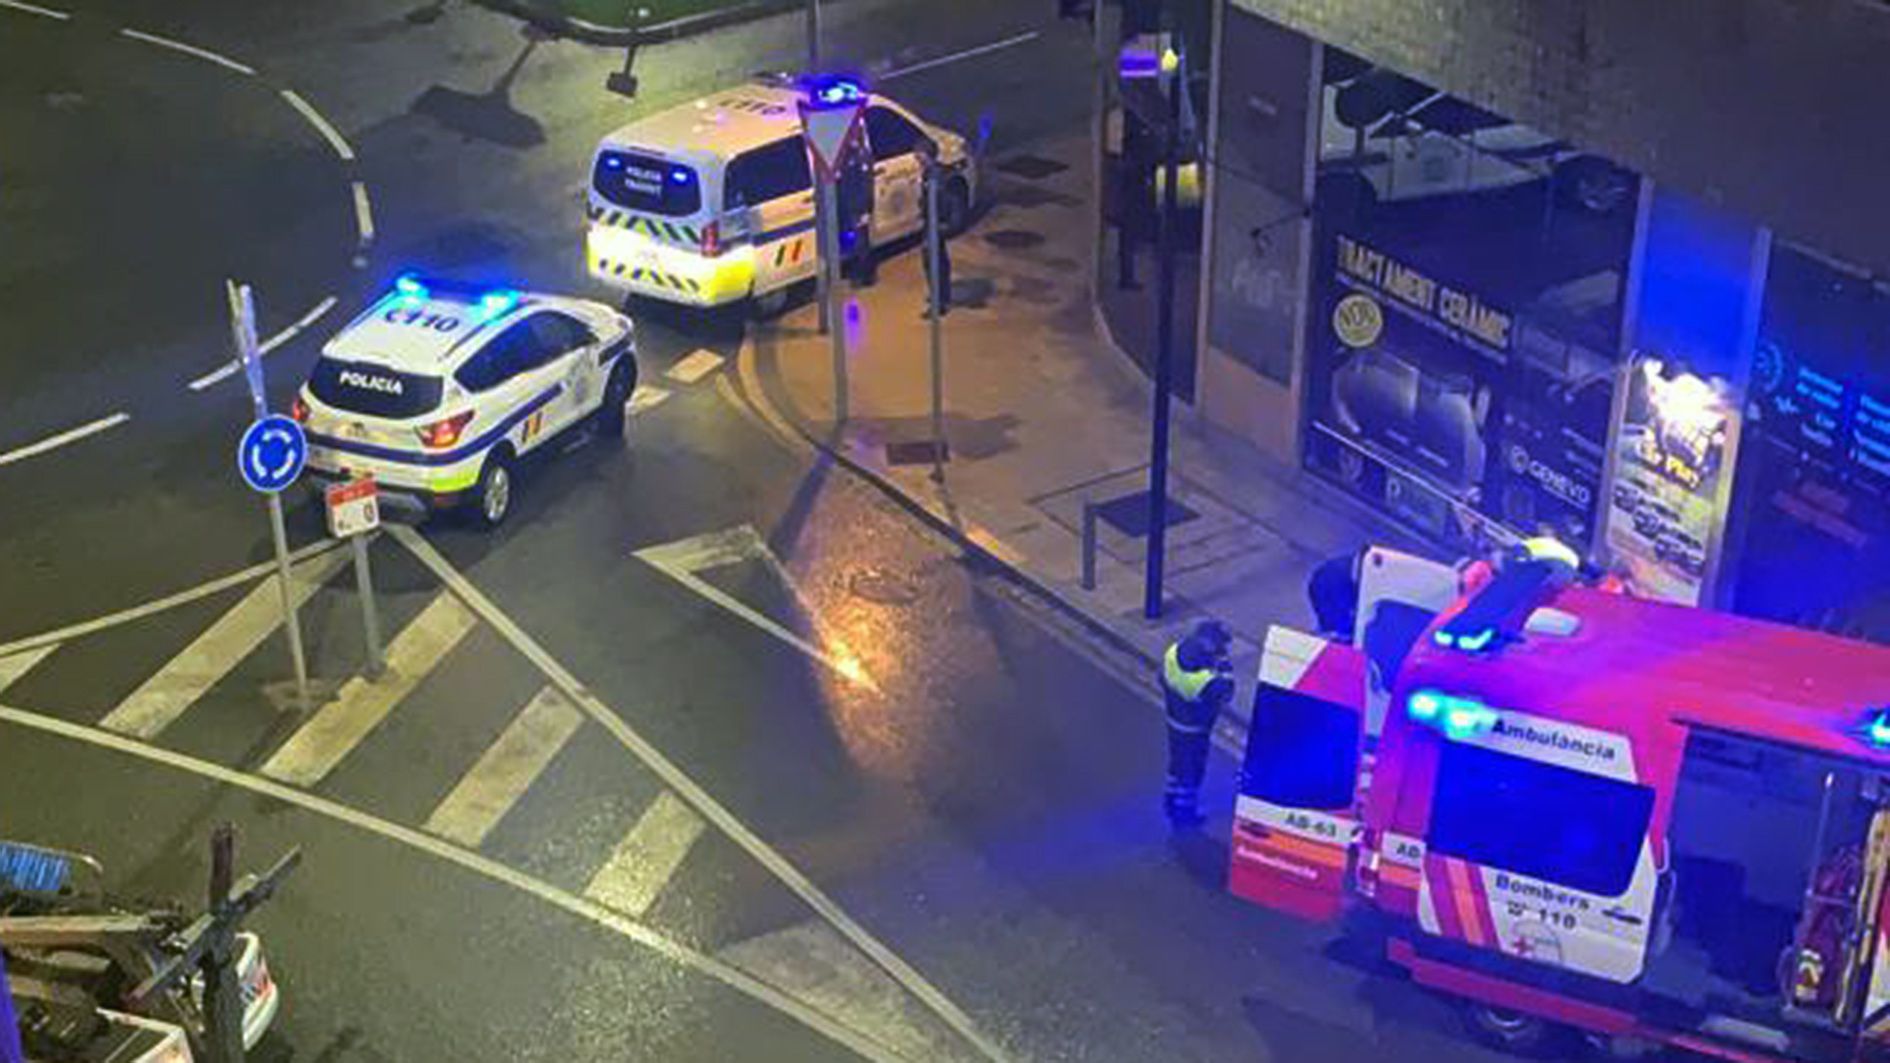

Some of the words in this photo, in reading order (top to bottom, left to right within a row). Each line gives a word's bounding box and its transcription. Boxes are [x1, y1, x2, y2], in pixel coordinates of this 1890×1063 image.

[1336, 234, 1436, 312] TRACTAMENT
[339, 371, 404, 395] POLICIA
[1528, 460, 1590, 504] GENEVO
[1492, 708, 1616, 760] Ambulància
[1495, 873, 1590, 911] Bombers
